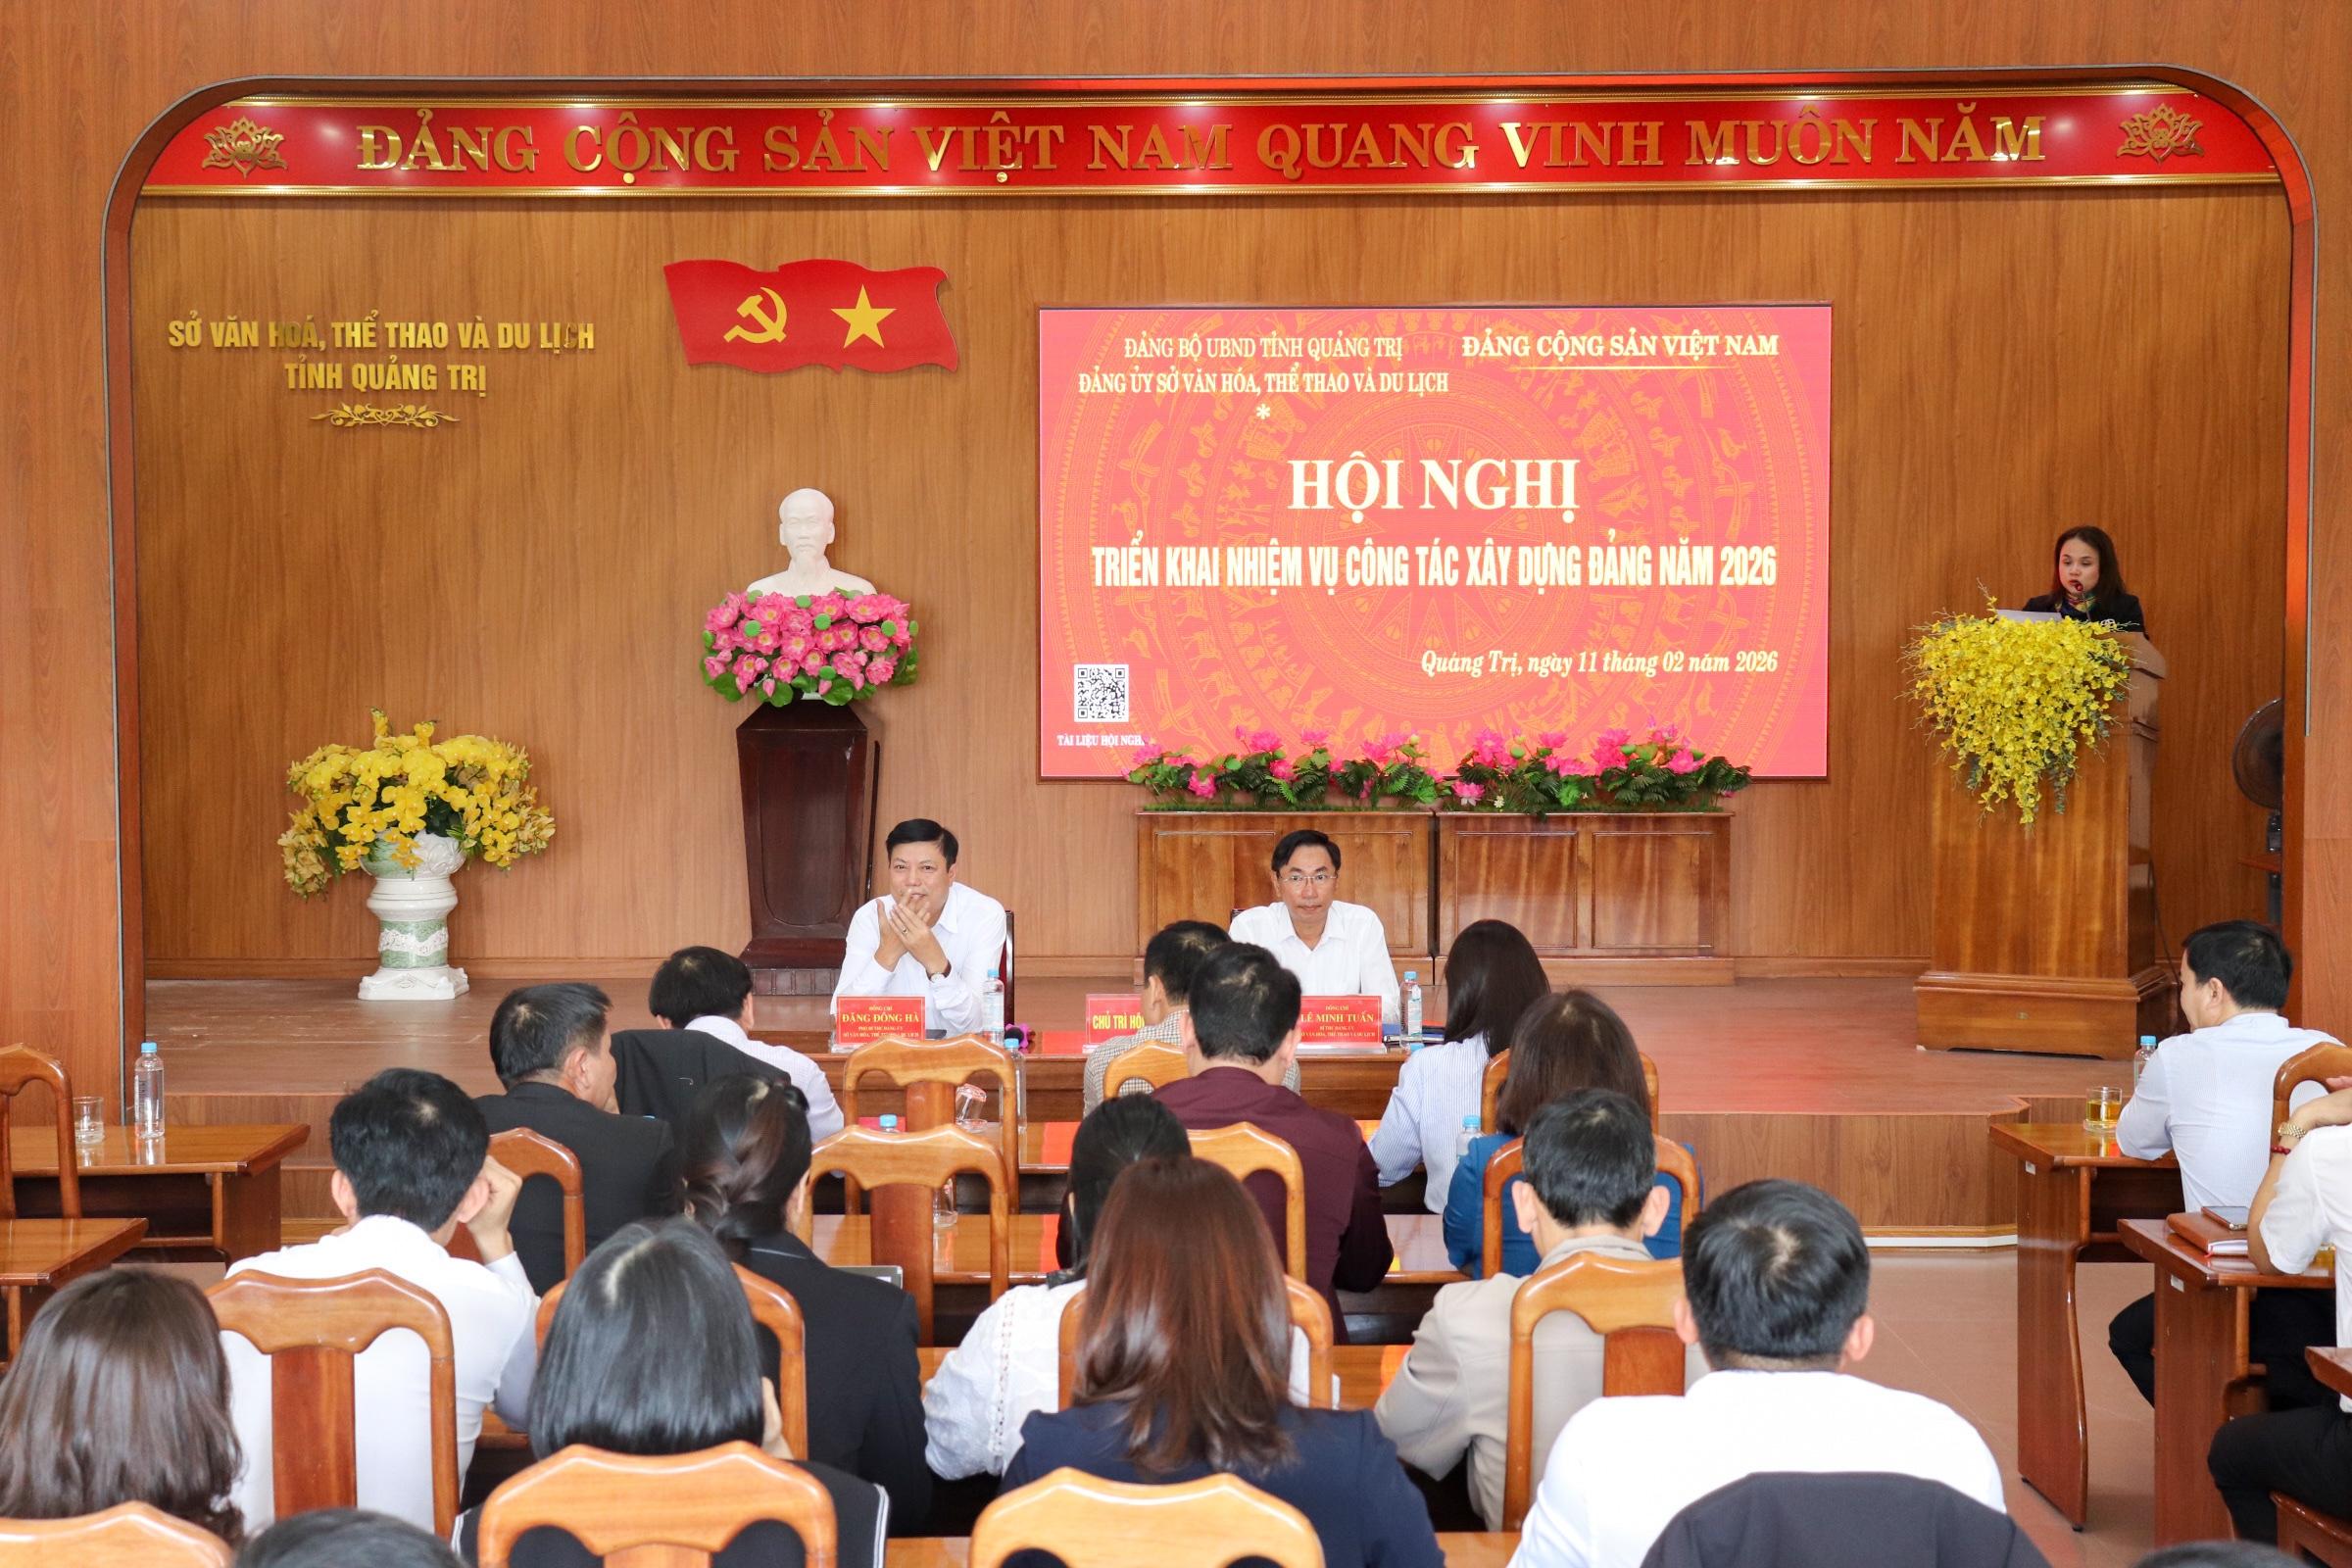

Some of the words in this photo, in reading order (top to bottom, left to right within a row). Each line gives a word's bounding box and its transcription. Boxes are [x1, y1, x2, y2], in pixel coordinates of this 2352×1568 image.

[356, 108, 540, 172] ĐẢNG
[564, 111, 740, 184] CỘNG
[763, 109, 894, 172] SẢN
[909, 111, 1064, 183] VIỆT
[1087, 124, 1233, 170] NAM
[1256, 122, 1480, 180] QUANG
[1498, 122, 1664, 168] VINH
[1685, 104, 1878, 165] MUÔN
[1894, 102, 2046, 163] NĂM
[168, 310, 202, 347] SỞ
[210, 316, 259, 348] VĂN
[269, 315, 326, 351] HOÁ,
[331, 310, 379, 349] THỂ
[384, 322, 449, 349] THAO
[458, 316, 490, 350] VÀ
[497, 322, 530, 350] DU
[540, 322, 595, 354] LỊCH
[1124, 330, 1174, 358] ĐẢNG
[1177, 333, 1201, 362] BỘ
[1206, 337, 1256, 358] UBND
[1259, 330, 1303, 358] TỈNH
[1307, 330, 1370, 360] QUẢNG
[1374, 337, 1403, 362] TRỊ
[1462, 328, 1531, 357] ĐẢNG
[1537, 330, 1604, 362] CỘNG
[1610, 327, 1657, 356] SẢN
[1662, 329, 1719, 361] VIỆT
[1725, 335, 1779, 356] NAM
[284, 355, 343, 389] TỈNH
[351, 355, 437, 392] QUẢNG
[446, 365, 486, 397] TRỊ
[1078, 366, 1126, 393] ĐẢNG
[1130, 365, 1153, 393] ỦY
[1156, 365, 1179, 393] SỞ
[1182, 368, 1218, 393] VĂN
[1221, 367, 1261, 396] HÓA,
[1264, 363, 1299, 393] THỂ
[1302, 372, 1349, 393] THAO
[1353, 368, 1376, 393] VÀ
[1380, 372, 1403, 393] DU
[1407, 372, 1448, 398] LỊCH
[1287, 451, 1403, 523] HỘI
[1418, 459, 1581, 523] NGHỊ
[1092, 530, 1158, 586] TRIỂN
[1166, 547, 1219, 586] KHAI
[1227, 538, 1302, 595] NHIỆM
[1309, 546, 1339, 595] VỤ
[1346, 537, 1409, 586] CÔNG
[1415, 538, 1459, 586] TÁC
[1466, 538, 1512, 586] XÂY
[1519, 542, 1581, 595] DỰNG
[1589, 528, 1652, 586] ĐẢNG
[1659, 537, 1713, 586] NĂM
[1720, 546, 1777, 586] 2026
[1489, 651, 1523, 676] Trị,
[1528, 652, 1572, 677] ngày
[1578, 652, 1596, 672] 11
[1602, 651, 1658, 676] tháng
[1662, 651, 1684, 672] 02
[1689, 653, 1730, 672] năm
[1736, 651, 1779, 672] 2026
[1056, 733, 1074, 746] TÀI
[1101, 733, 1118, 748] HỘI
[905, 1011, 919, 1022] HÀ
[1093, 1010, 1111, 1029] CHỦ
[1112, 1012, 1127, 1029] TRÌ
[1316, 1013, 1344, 1022] MINH
[1348, 1010, 1374, 1022] TUẤN
